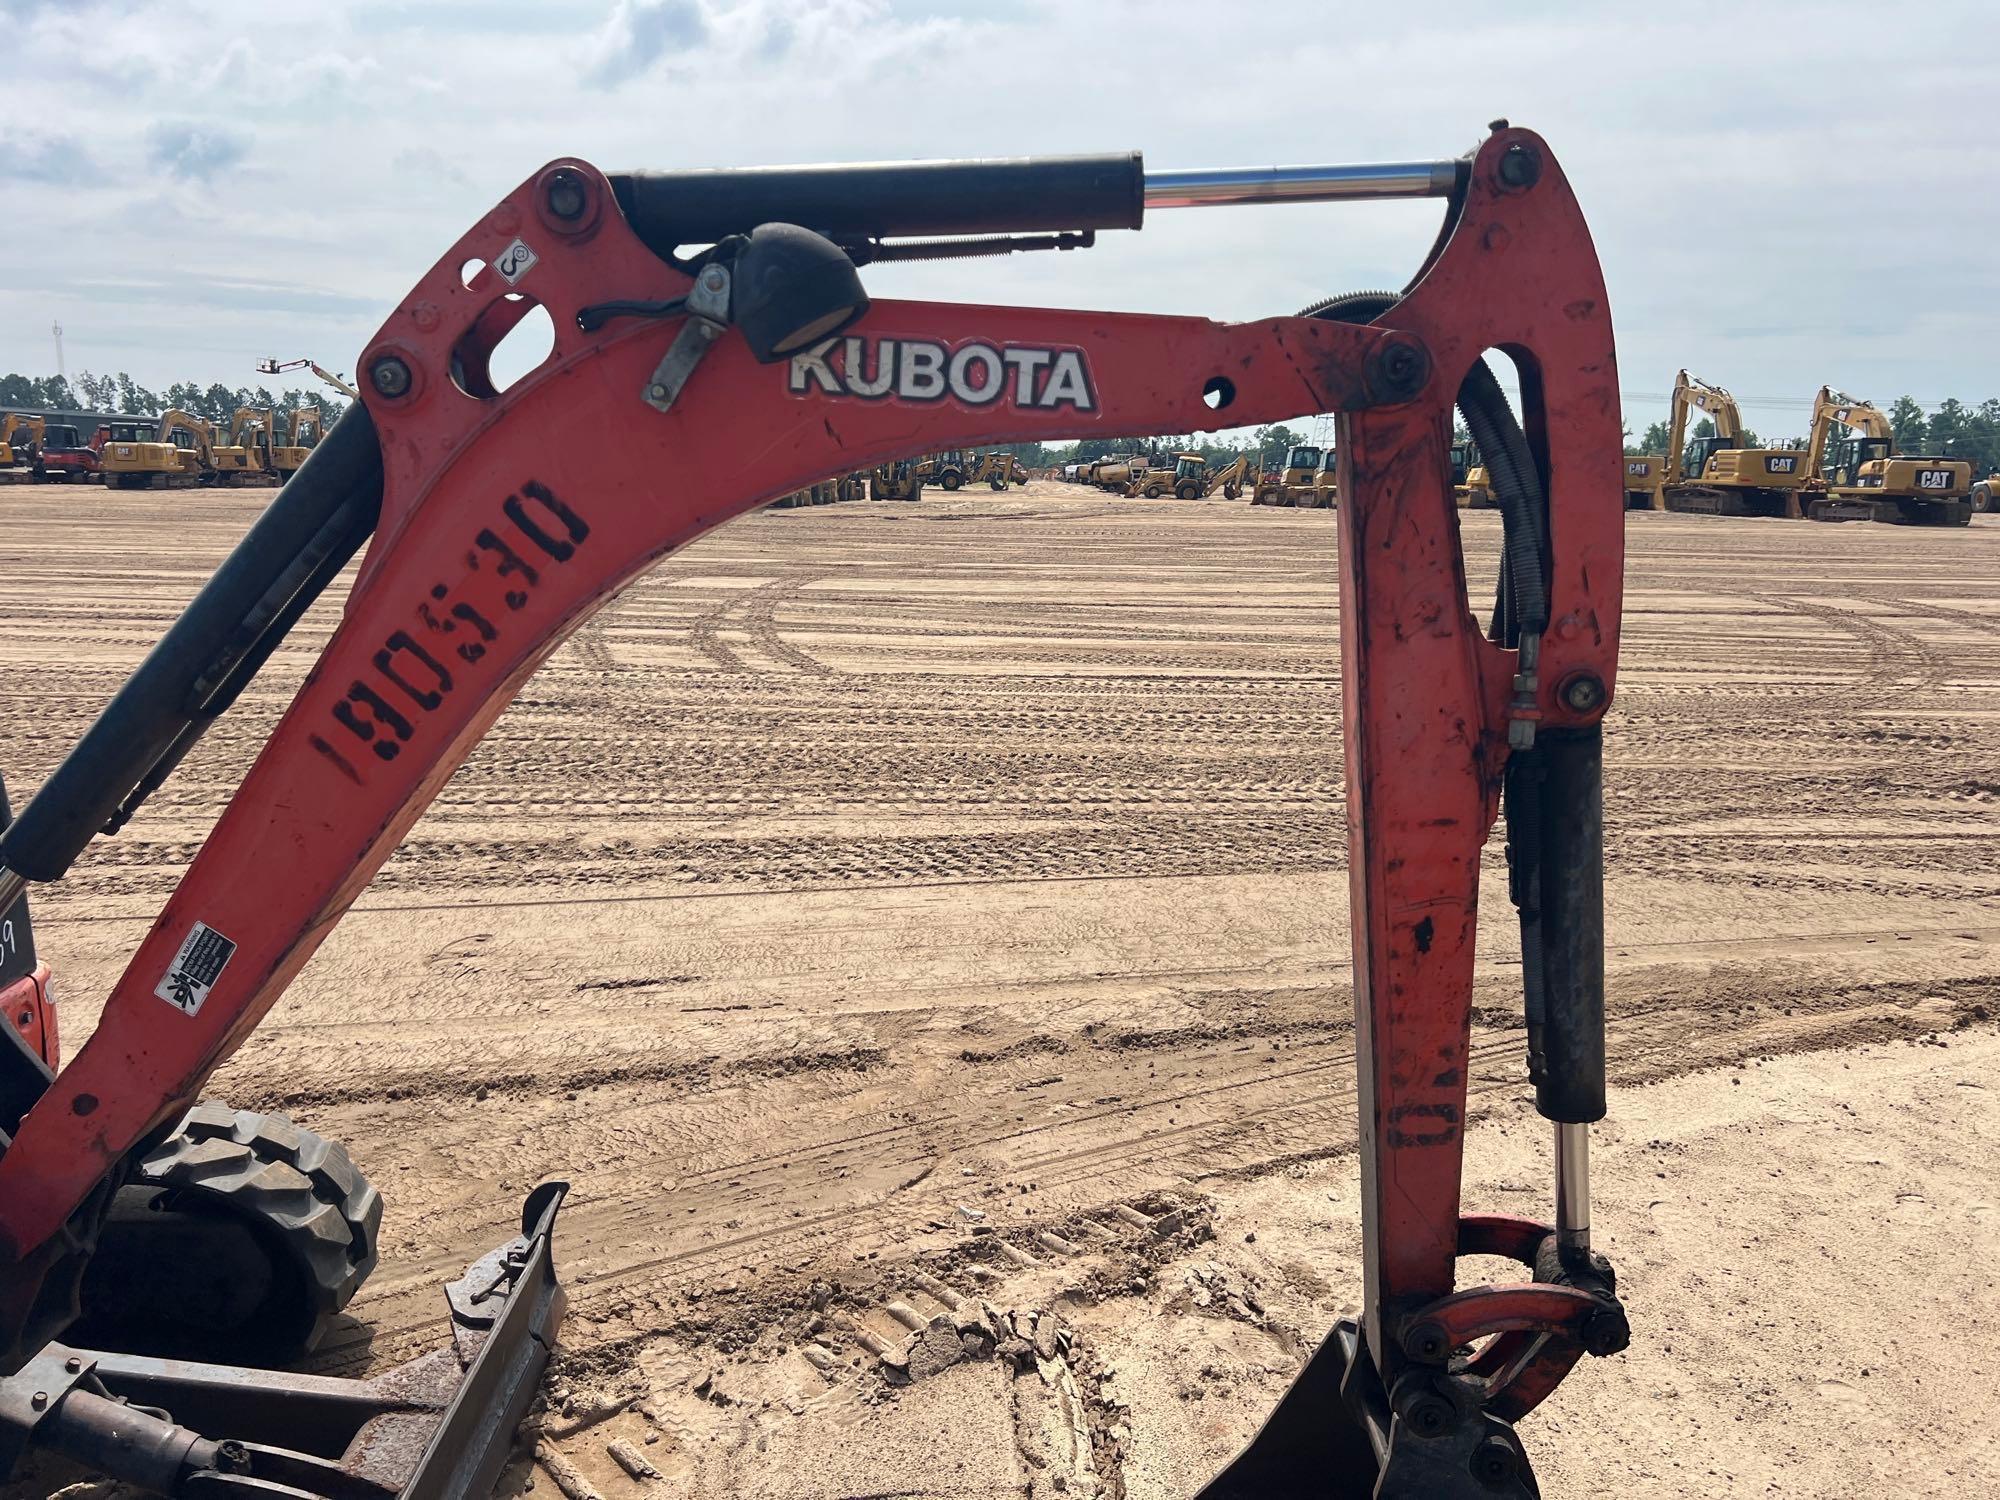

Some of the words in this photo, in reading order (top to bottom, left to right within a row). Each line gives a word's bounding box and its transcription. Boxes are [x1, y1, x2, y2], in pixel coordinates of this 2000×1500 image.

[789, 337, 1092, 409] KUBOTA
[1628, 463, 1647, 475] CAT
[1771, 458, 1793, 472] CAT
[1921, 471, 1949, 489] CAT
